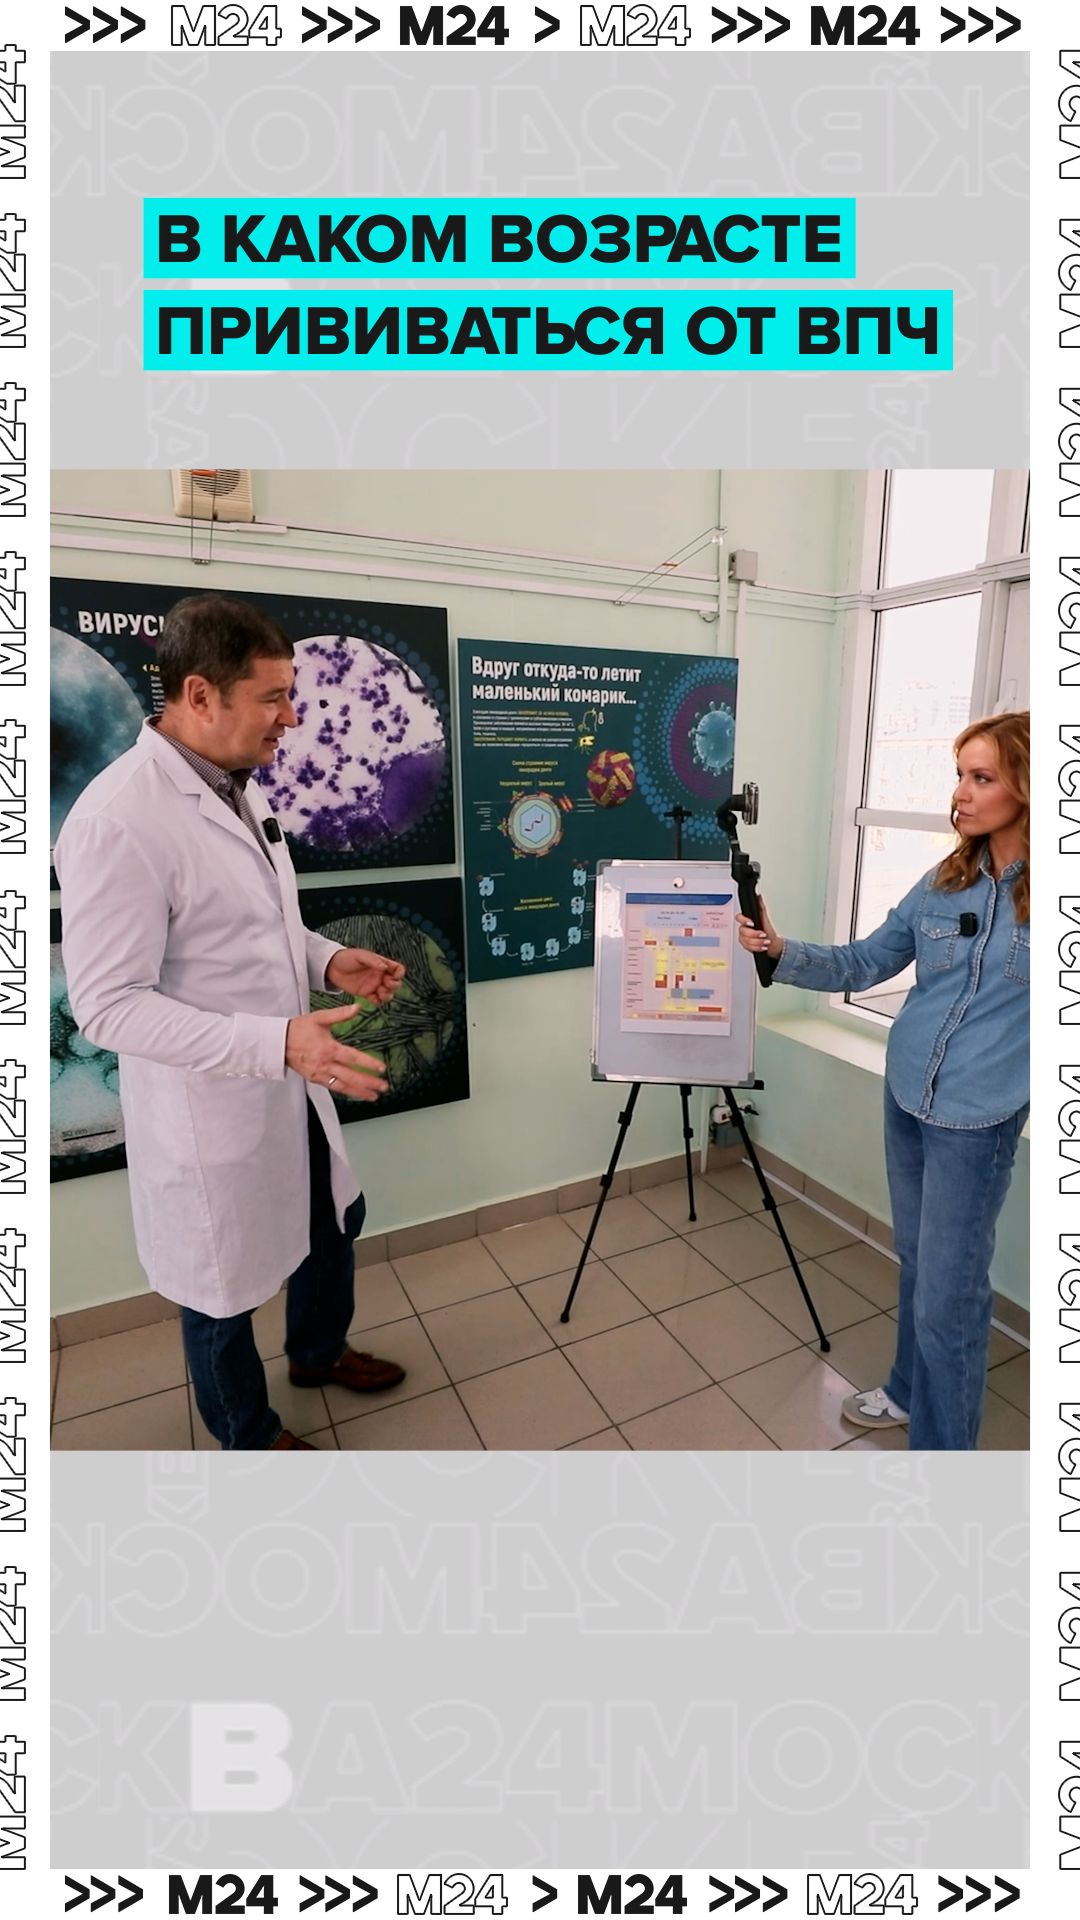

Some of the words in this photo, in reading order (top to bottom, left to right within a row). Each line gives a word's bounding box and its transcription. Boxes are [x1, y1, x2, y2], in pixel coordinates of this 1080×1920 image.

[77, 610, 165, 637] ВИРУС
[472, 655, 520, 680] Вдруг
[524, 662, 598, 682] откуда-то
[601, 668, 641, 682] летит
[472, 683, 560, 702] маленький
[564, 688, 637, 707] комарик...
